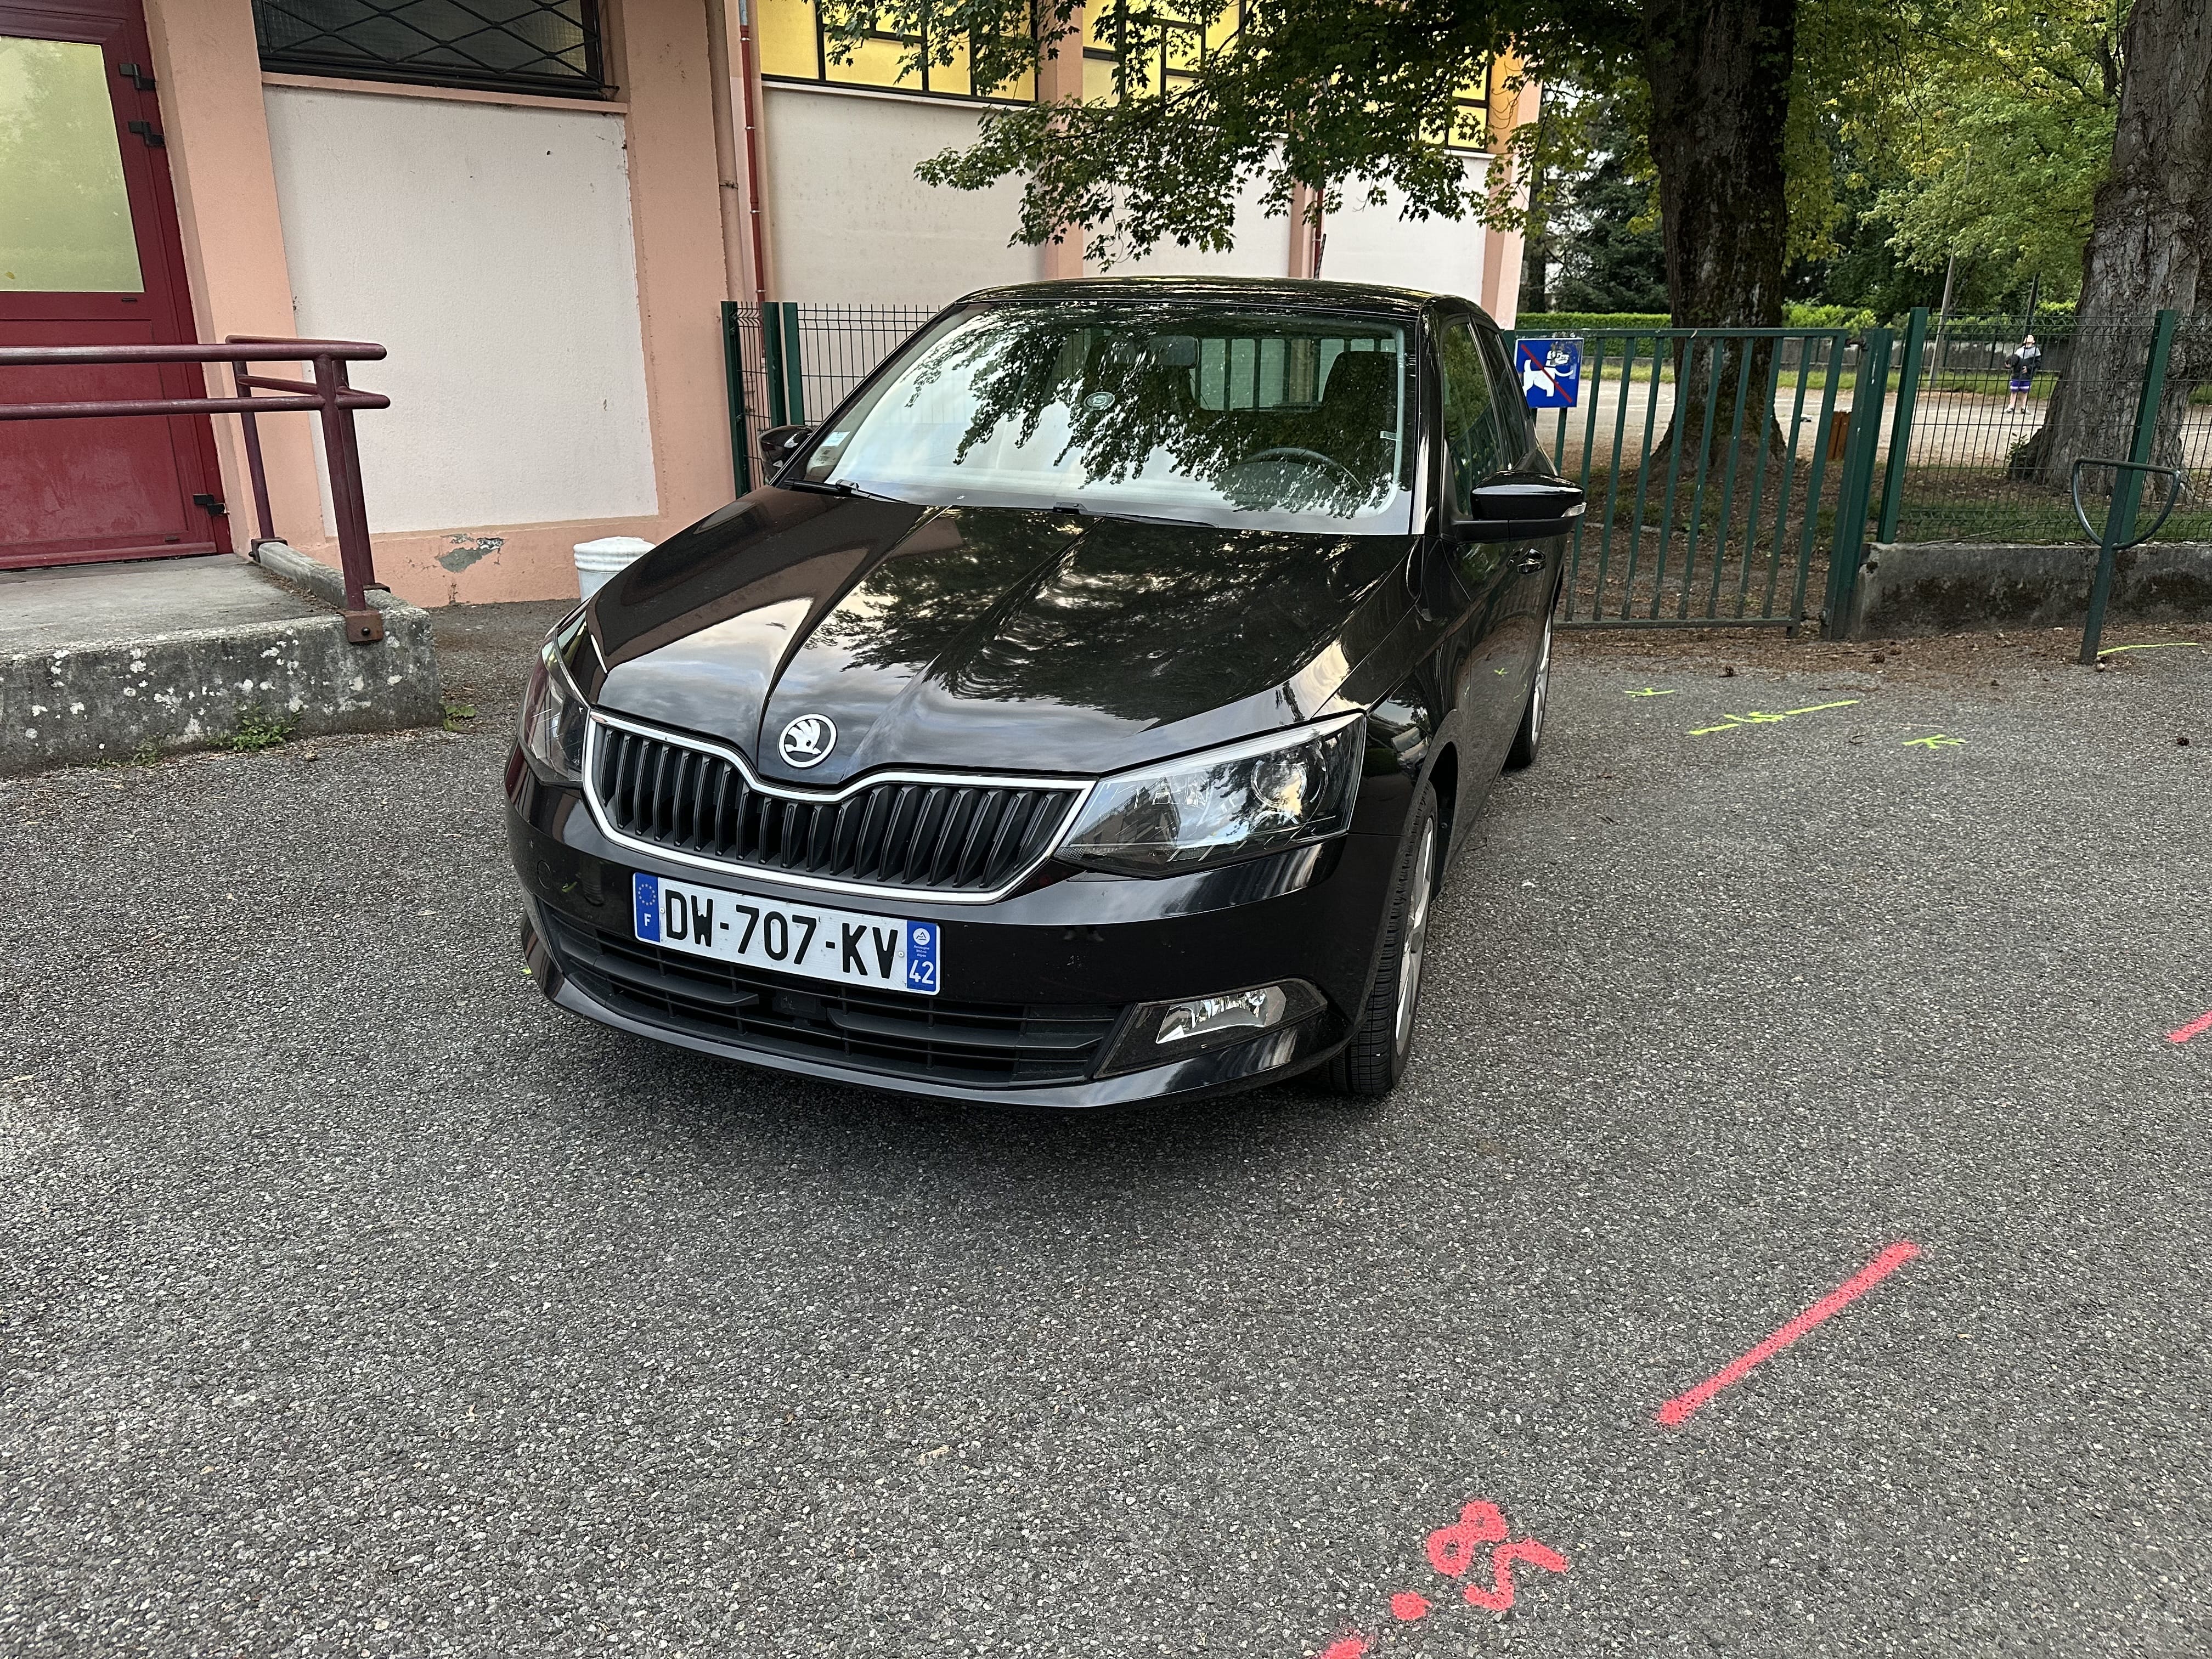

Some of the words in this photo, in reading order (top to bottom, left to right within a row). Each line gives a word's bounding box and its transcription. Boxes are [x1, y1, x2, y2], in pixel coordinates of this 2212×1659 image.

[644, 912, 652, 927] F
[665, 889, 899, 979] DW-707-KV
[909, 960, 934, 984] 42
